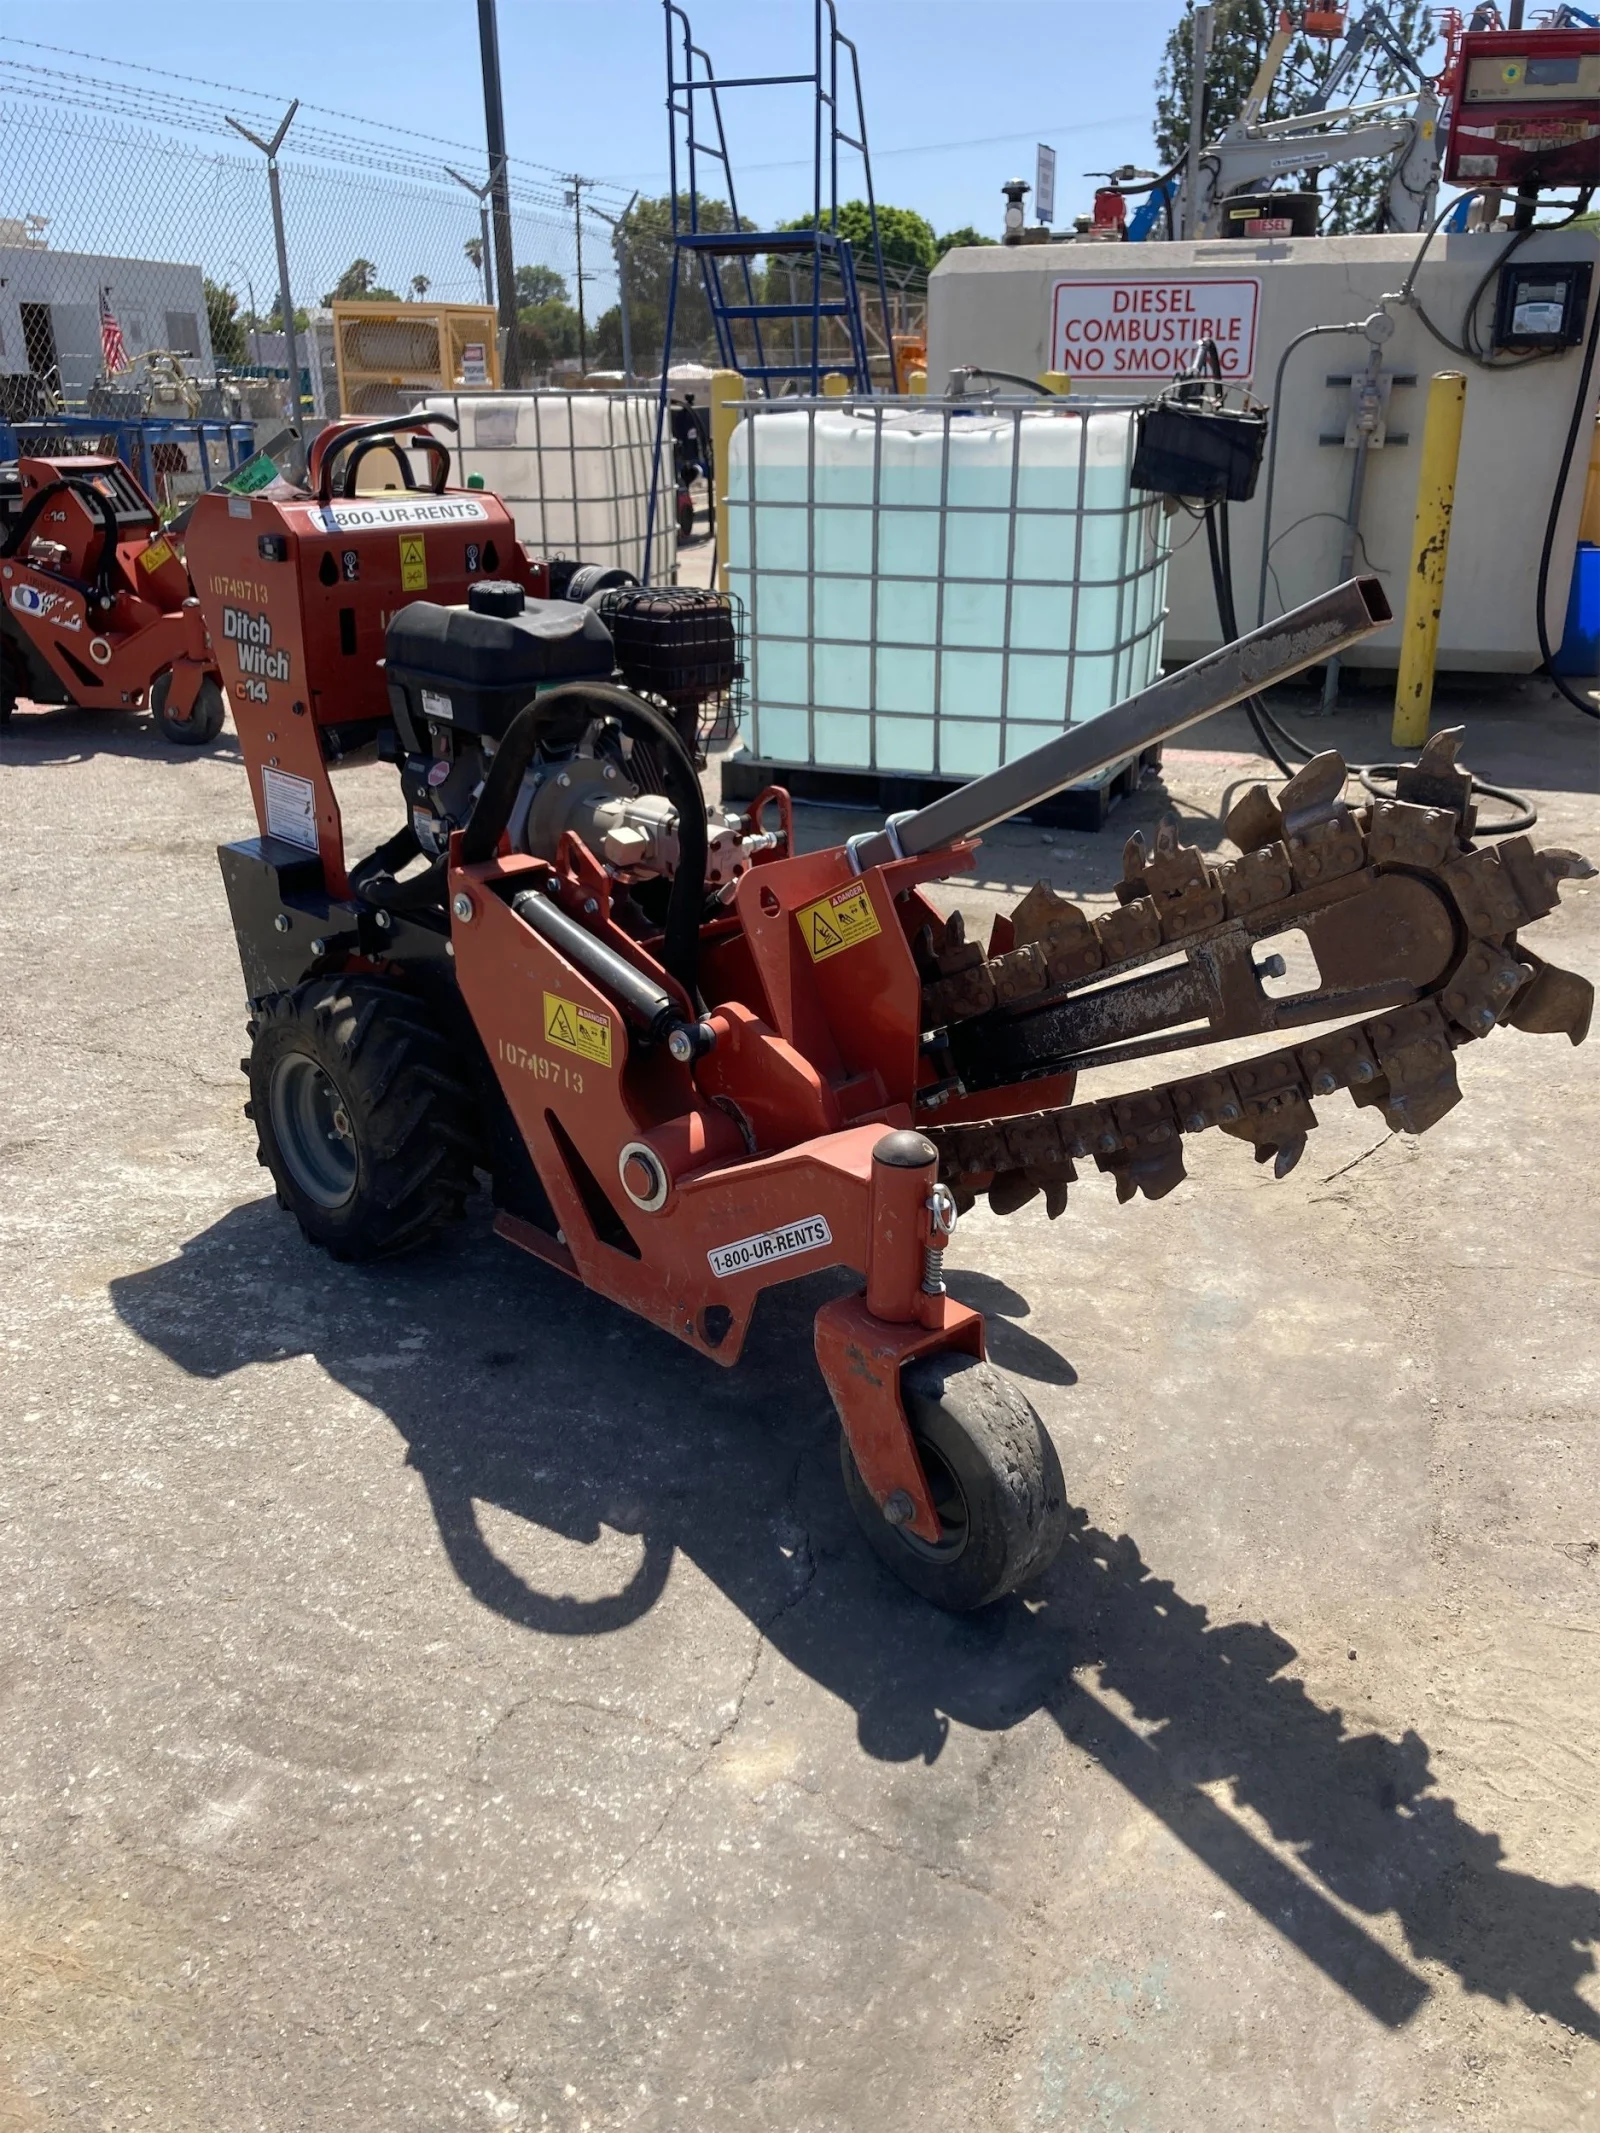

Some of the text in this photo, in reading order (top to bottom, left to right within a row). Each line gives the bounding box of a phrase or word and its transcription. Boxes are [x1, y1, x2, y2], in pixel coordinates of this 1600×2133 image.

[1248, 219, 1286, 231] ESEL
[1112, 289, 1196, 313] DIESEL
[1065, 318, 1242, 342] COMBUSTIBLE
[1065, 347, 1239, 371] NO SMOKIG
[318, 504, 479, 528] 1-800-UR-RENTS
[209, 576, 268, 604] 10749713
[223, 607, 271, 646] Ditch
[237, 643, 289, 681] Witch
[837, 885, 863, 903] DANGER
[583, 1010, 608, 1026] DANGER
[499, 1039, 583, 1094] 10749713
[714, 1223, 825, 1271] 1-800-UR-RENTS
